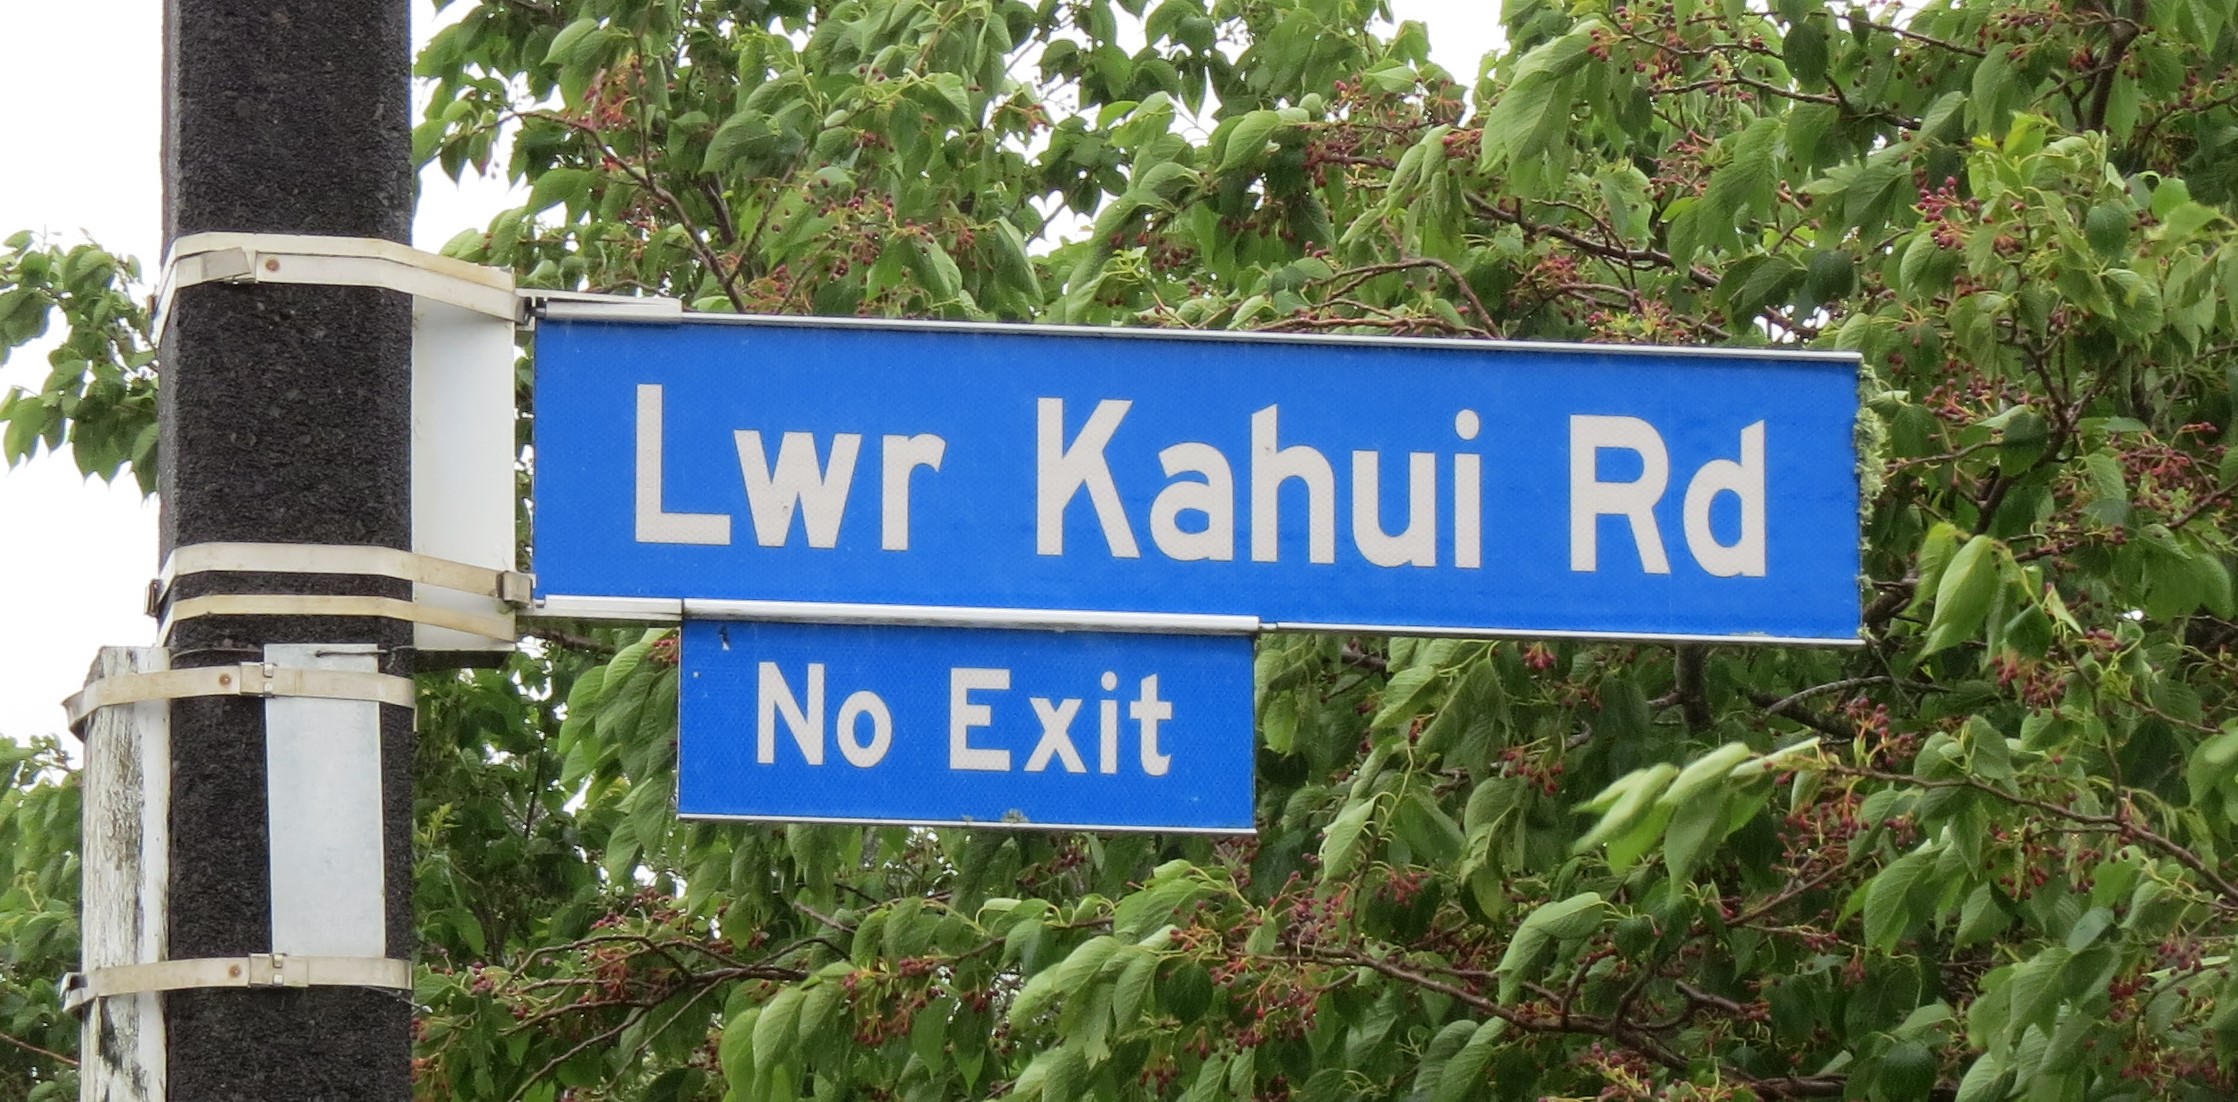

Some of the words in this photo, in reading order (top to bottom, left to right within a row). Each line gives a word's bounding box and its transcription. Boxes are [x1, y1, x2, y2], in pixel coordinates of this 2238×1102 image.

[635, 383, 947, 551] Lwr
[1036, 397, 1482, 569] Kahui
[1569, 414, 1767, 578] Rd
[757, 661, 893, 768] No
[949, 667, 1173, 777] Exit
